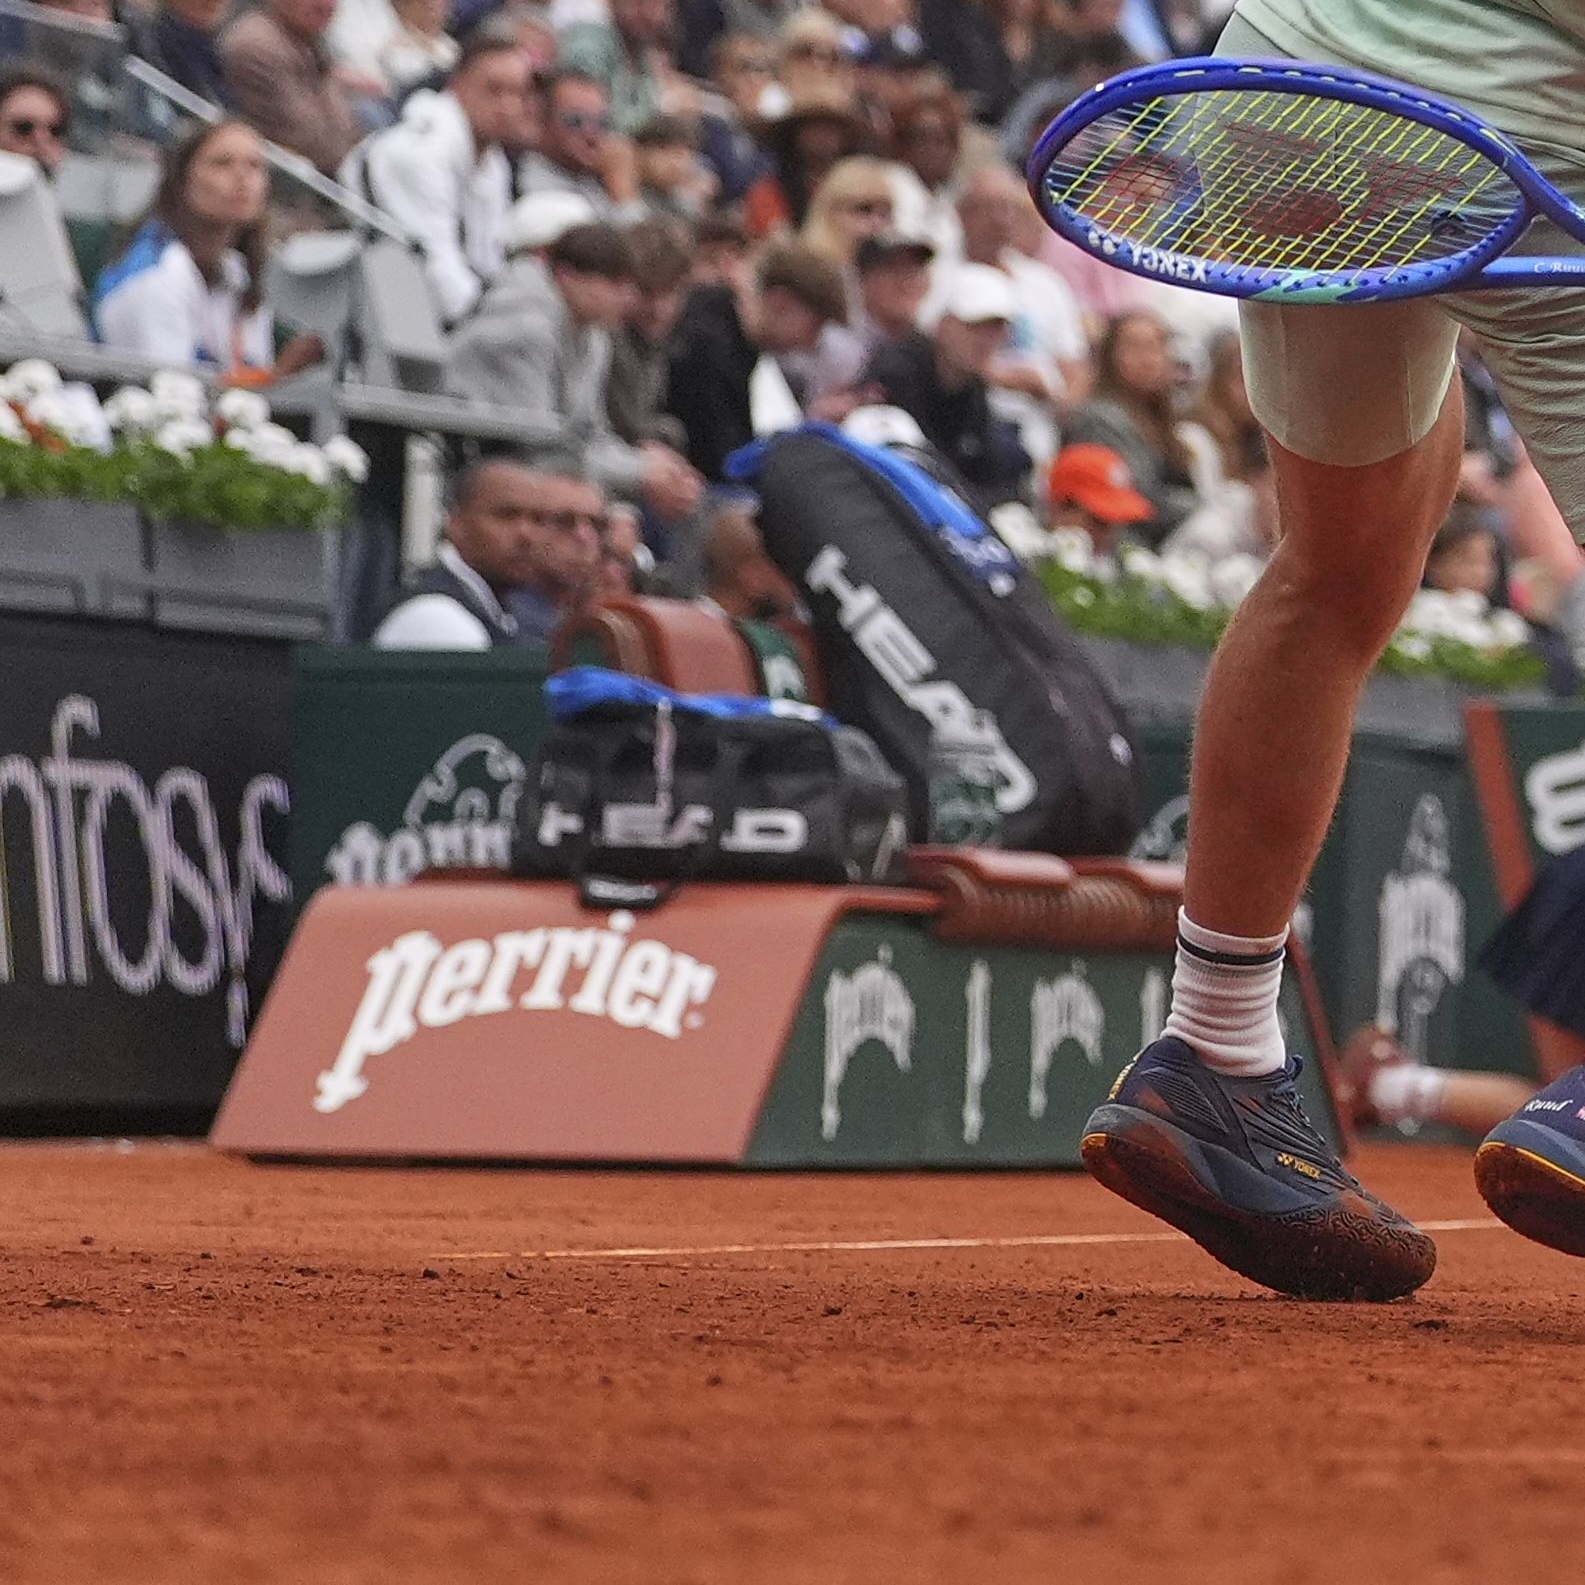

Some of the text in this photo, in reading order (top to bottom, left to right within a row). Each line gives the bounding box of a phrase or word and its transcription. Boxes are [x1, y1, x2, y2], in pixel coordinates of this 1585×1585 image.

[1131, 243, 1209, 285] YONEX
[312, 908, 720, 1115] perrier
[1292, 1159, 1322, 1181] YONEX
